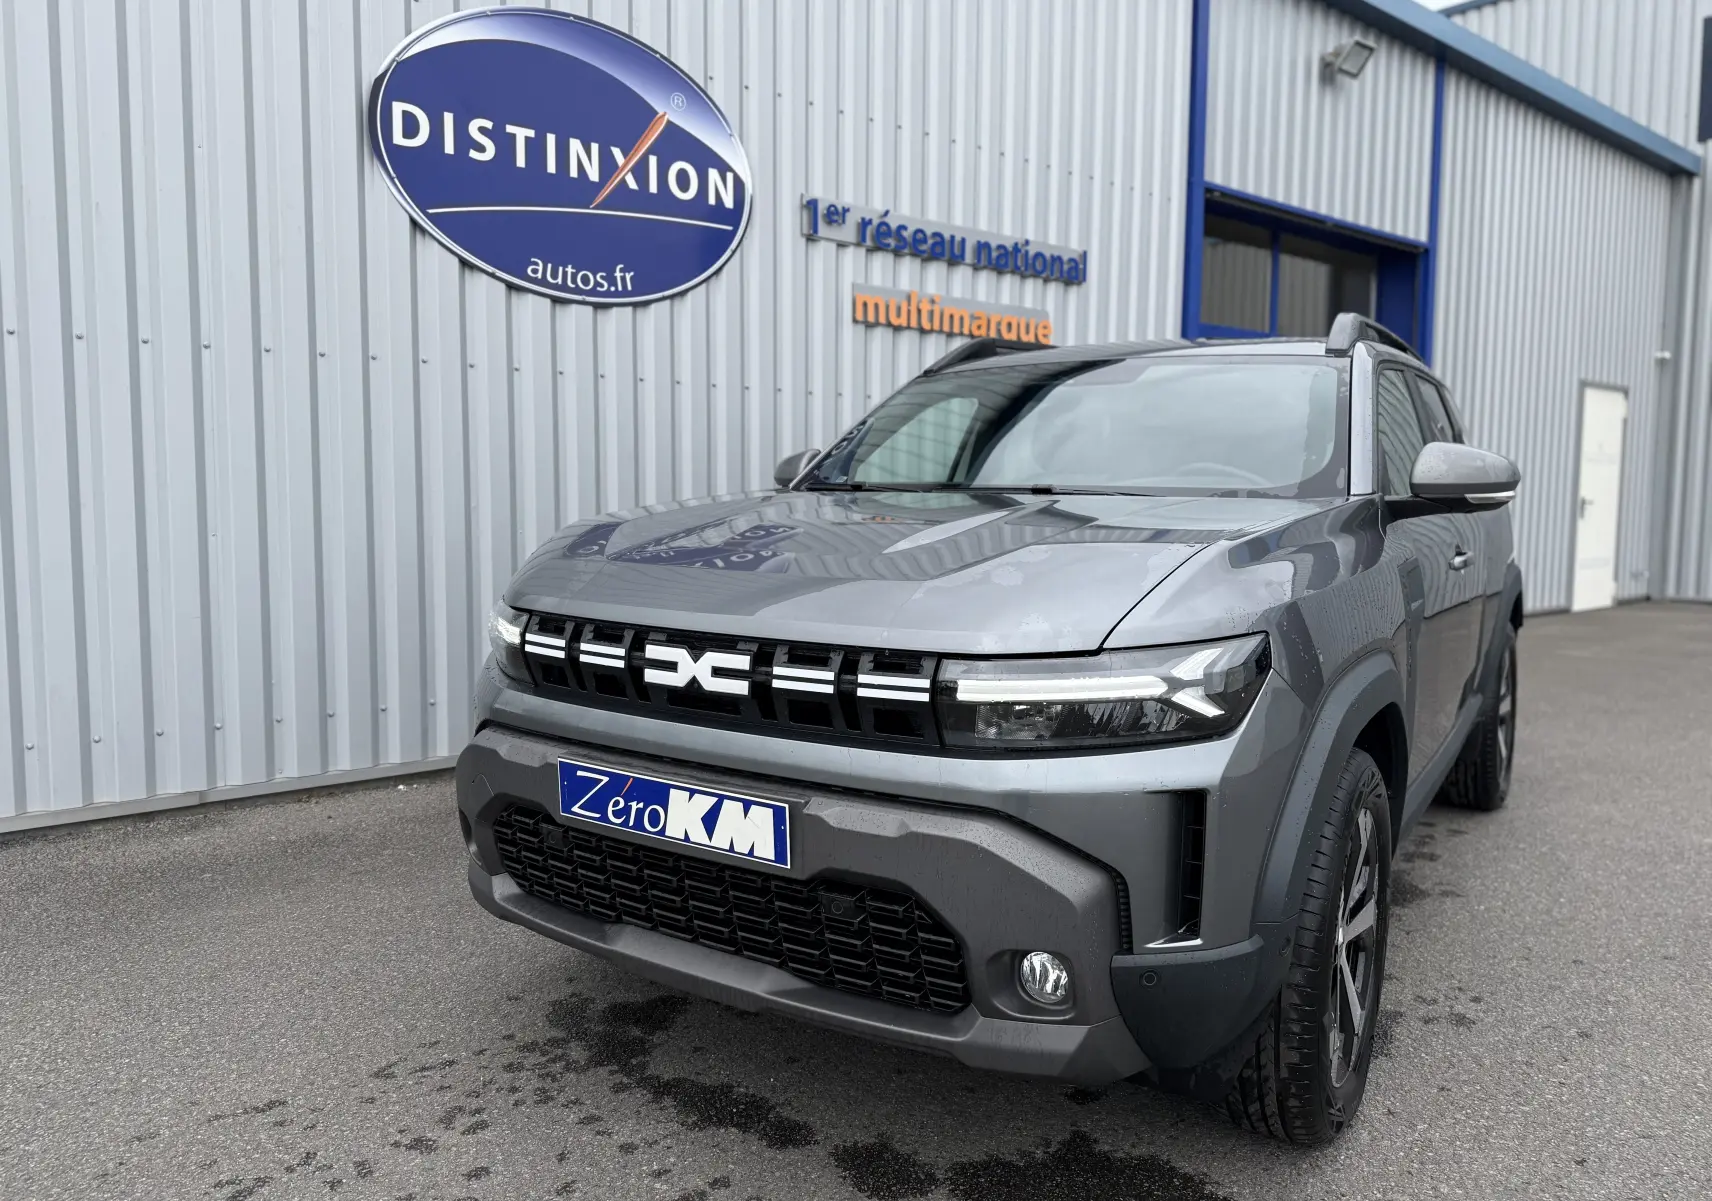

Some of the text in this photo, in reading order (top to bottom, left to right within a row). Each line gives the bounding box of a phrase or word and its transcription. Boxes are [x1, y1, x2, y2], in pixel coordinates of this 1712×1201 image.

[391, 100, 734, 209] DISTINXION
[527, 257, 635, 292] autos.fr
[859, 209, 967, 263] réseau
[976, 238, 1088, 284] national
